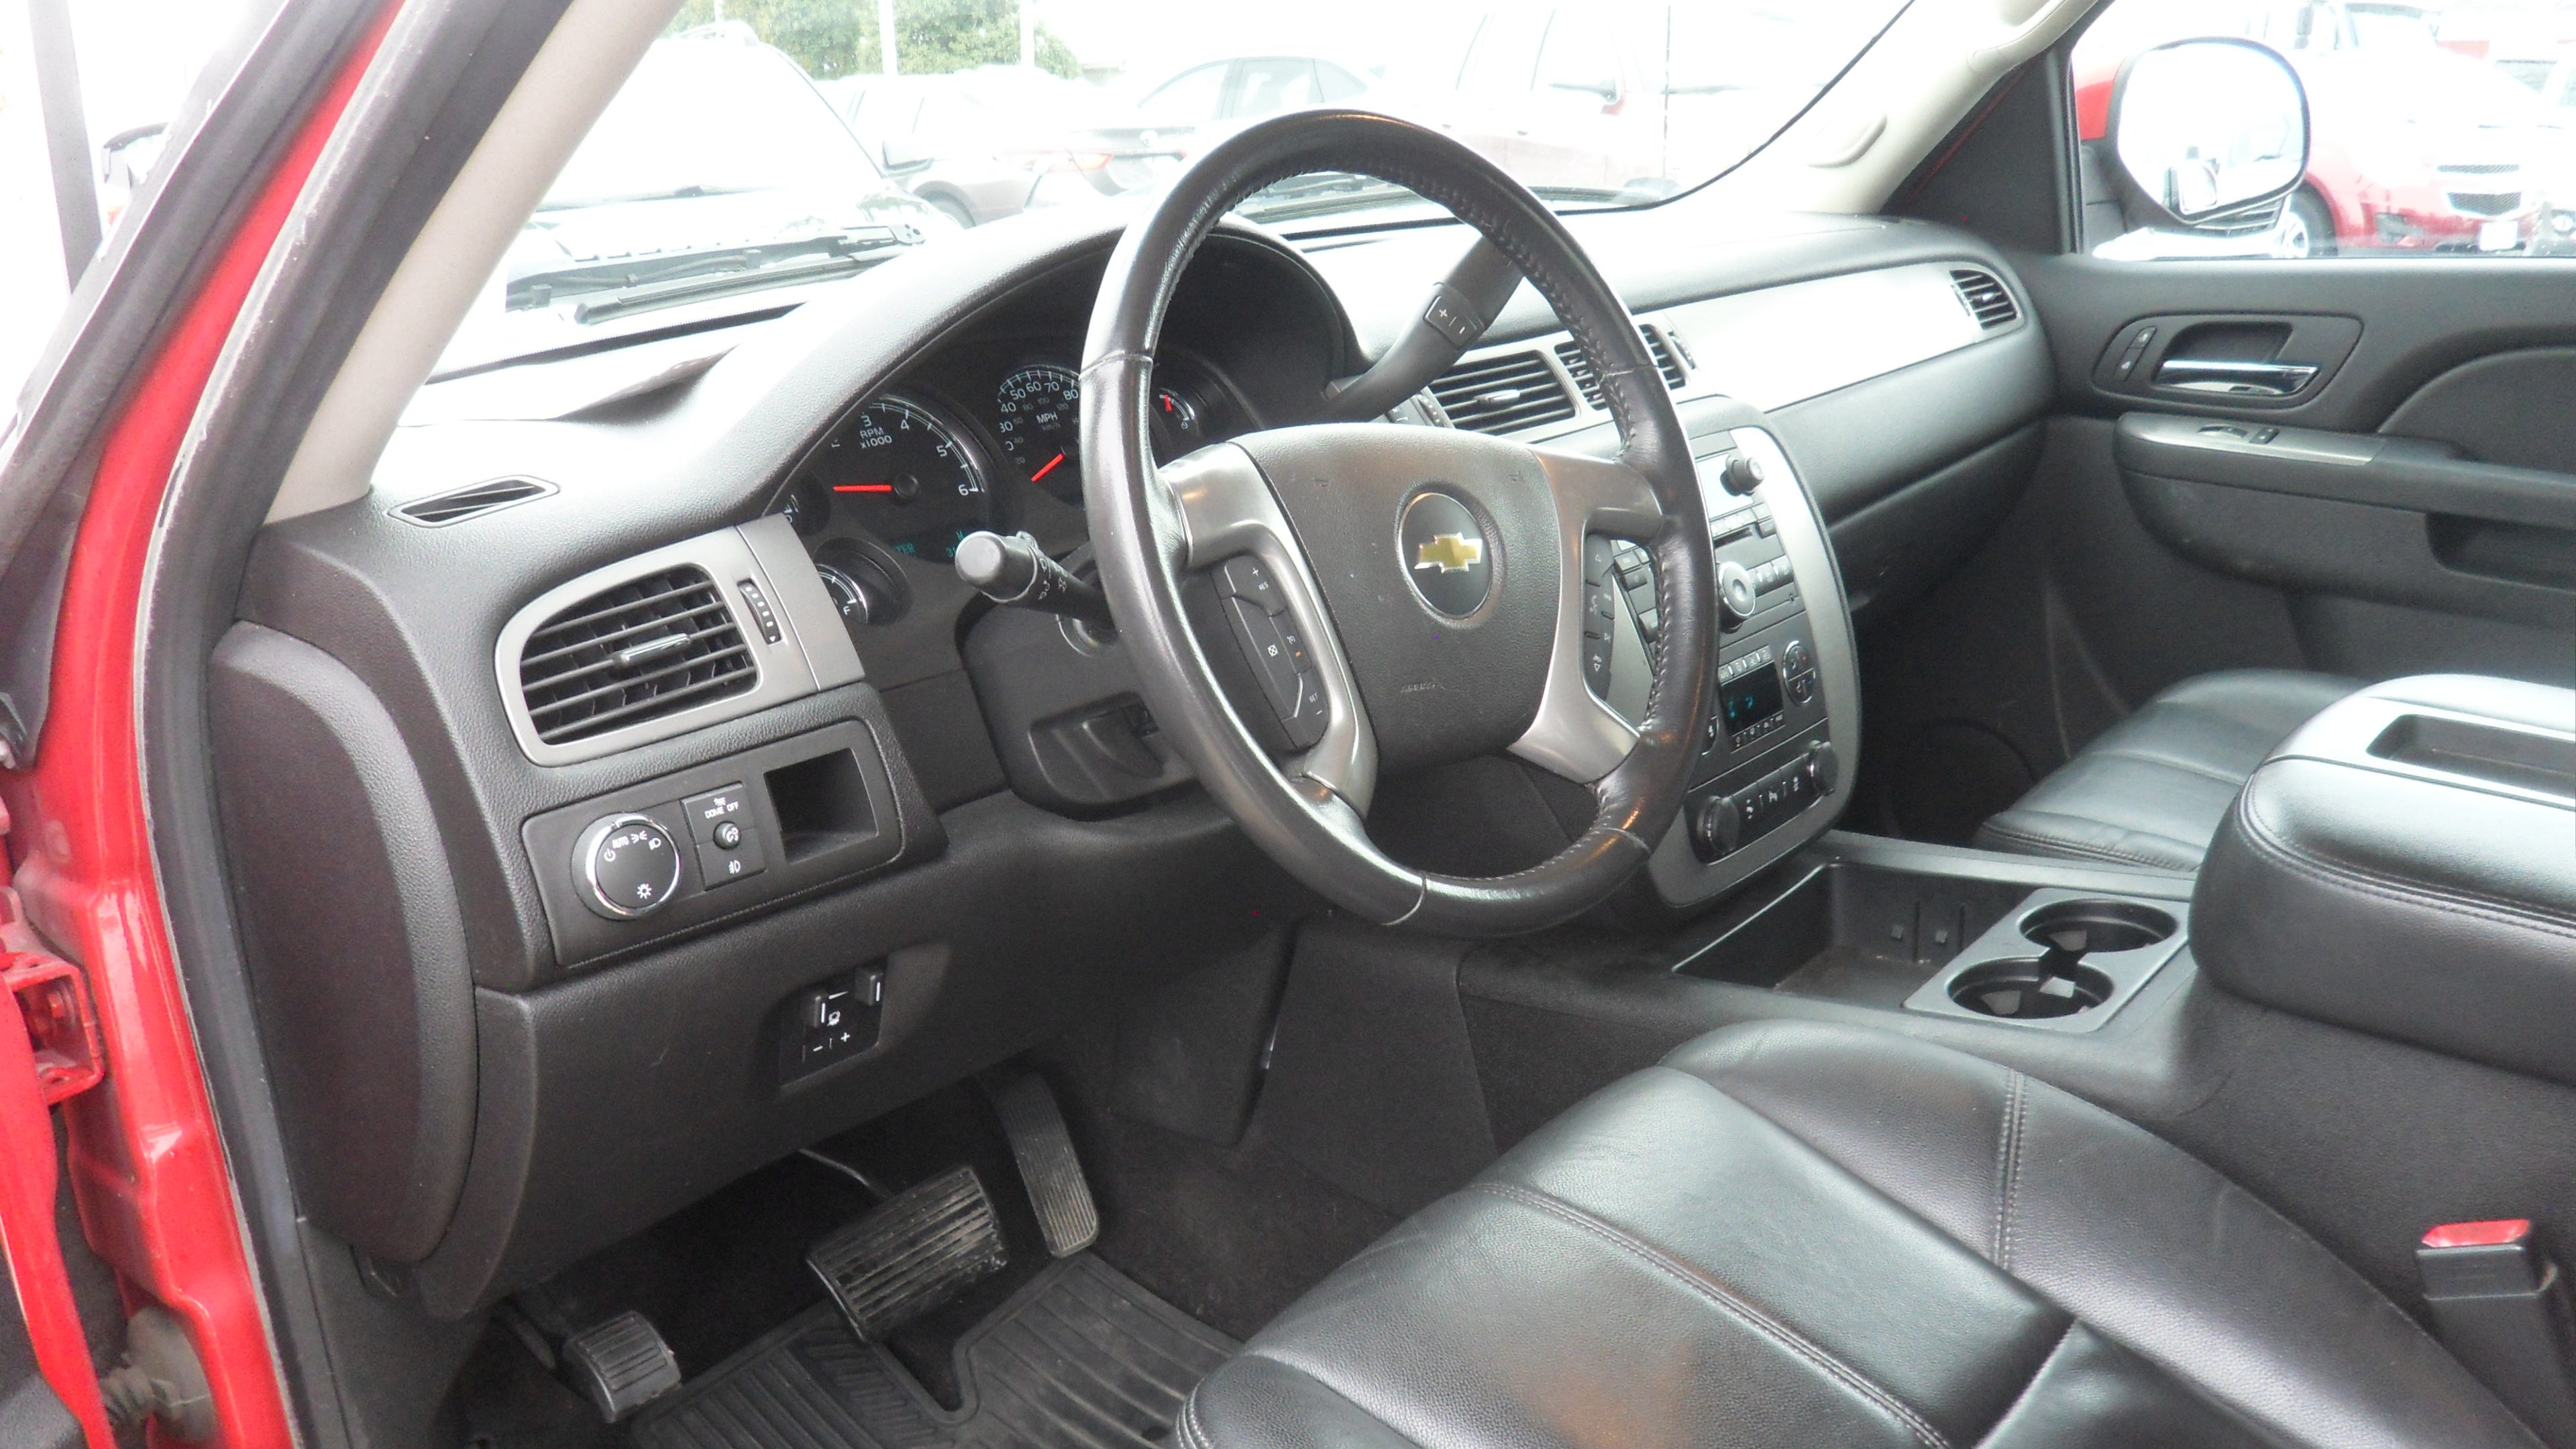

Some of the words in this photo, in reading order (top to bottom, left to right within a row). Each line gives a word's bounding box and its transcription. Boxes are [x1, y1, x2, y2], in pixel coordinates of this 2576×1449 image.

[1026, 382, 1041, 392] 60
[1044, 381, 1060, 393] 70
[1010, 388, 1026, 400] 50
[1063, 389, 1078, 400] 80
[1001, 402, 1016, 413] 40
[861, 415, 872, 427] 3
[1036, 412, 1058, 423] MPH
[901, 420, 910, 430] 4
[859, 427, 884, 439] RPM
[936, 445, 947, 457] 5
[958, 484, 969, 496] 6
[1258, 582, 1269, 591] RES
[843, 606, 851, 616] F
[1309, 693, 1318, 703] SET
[704, 807, 725, 819] DOME
[727, 802, 739, 812] OFF
[612, 836, 629, 849] AUTO
